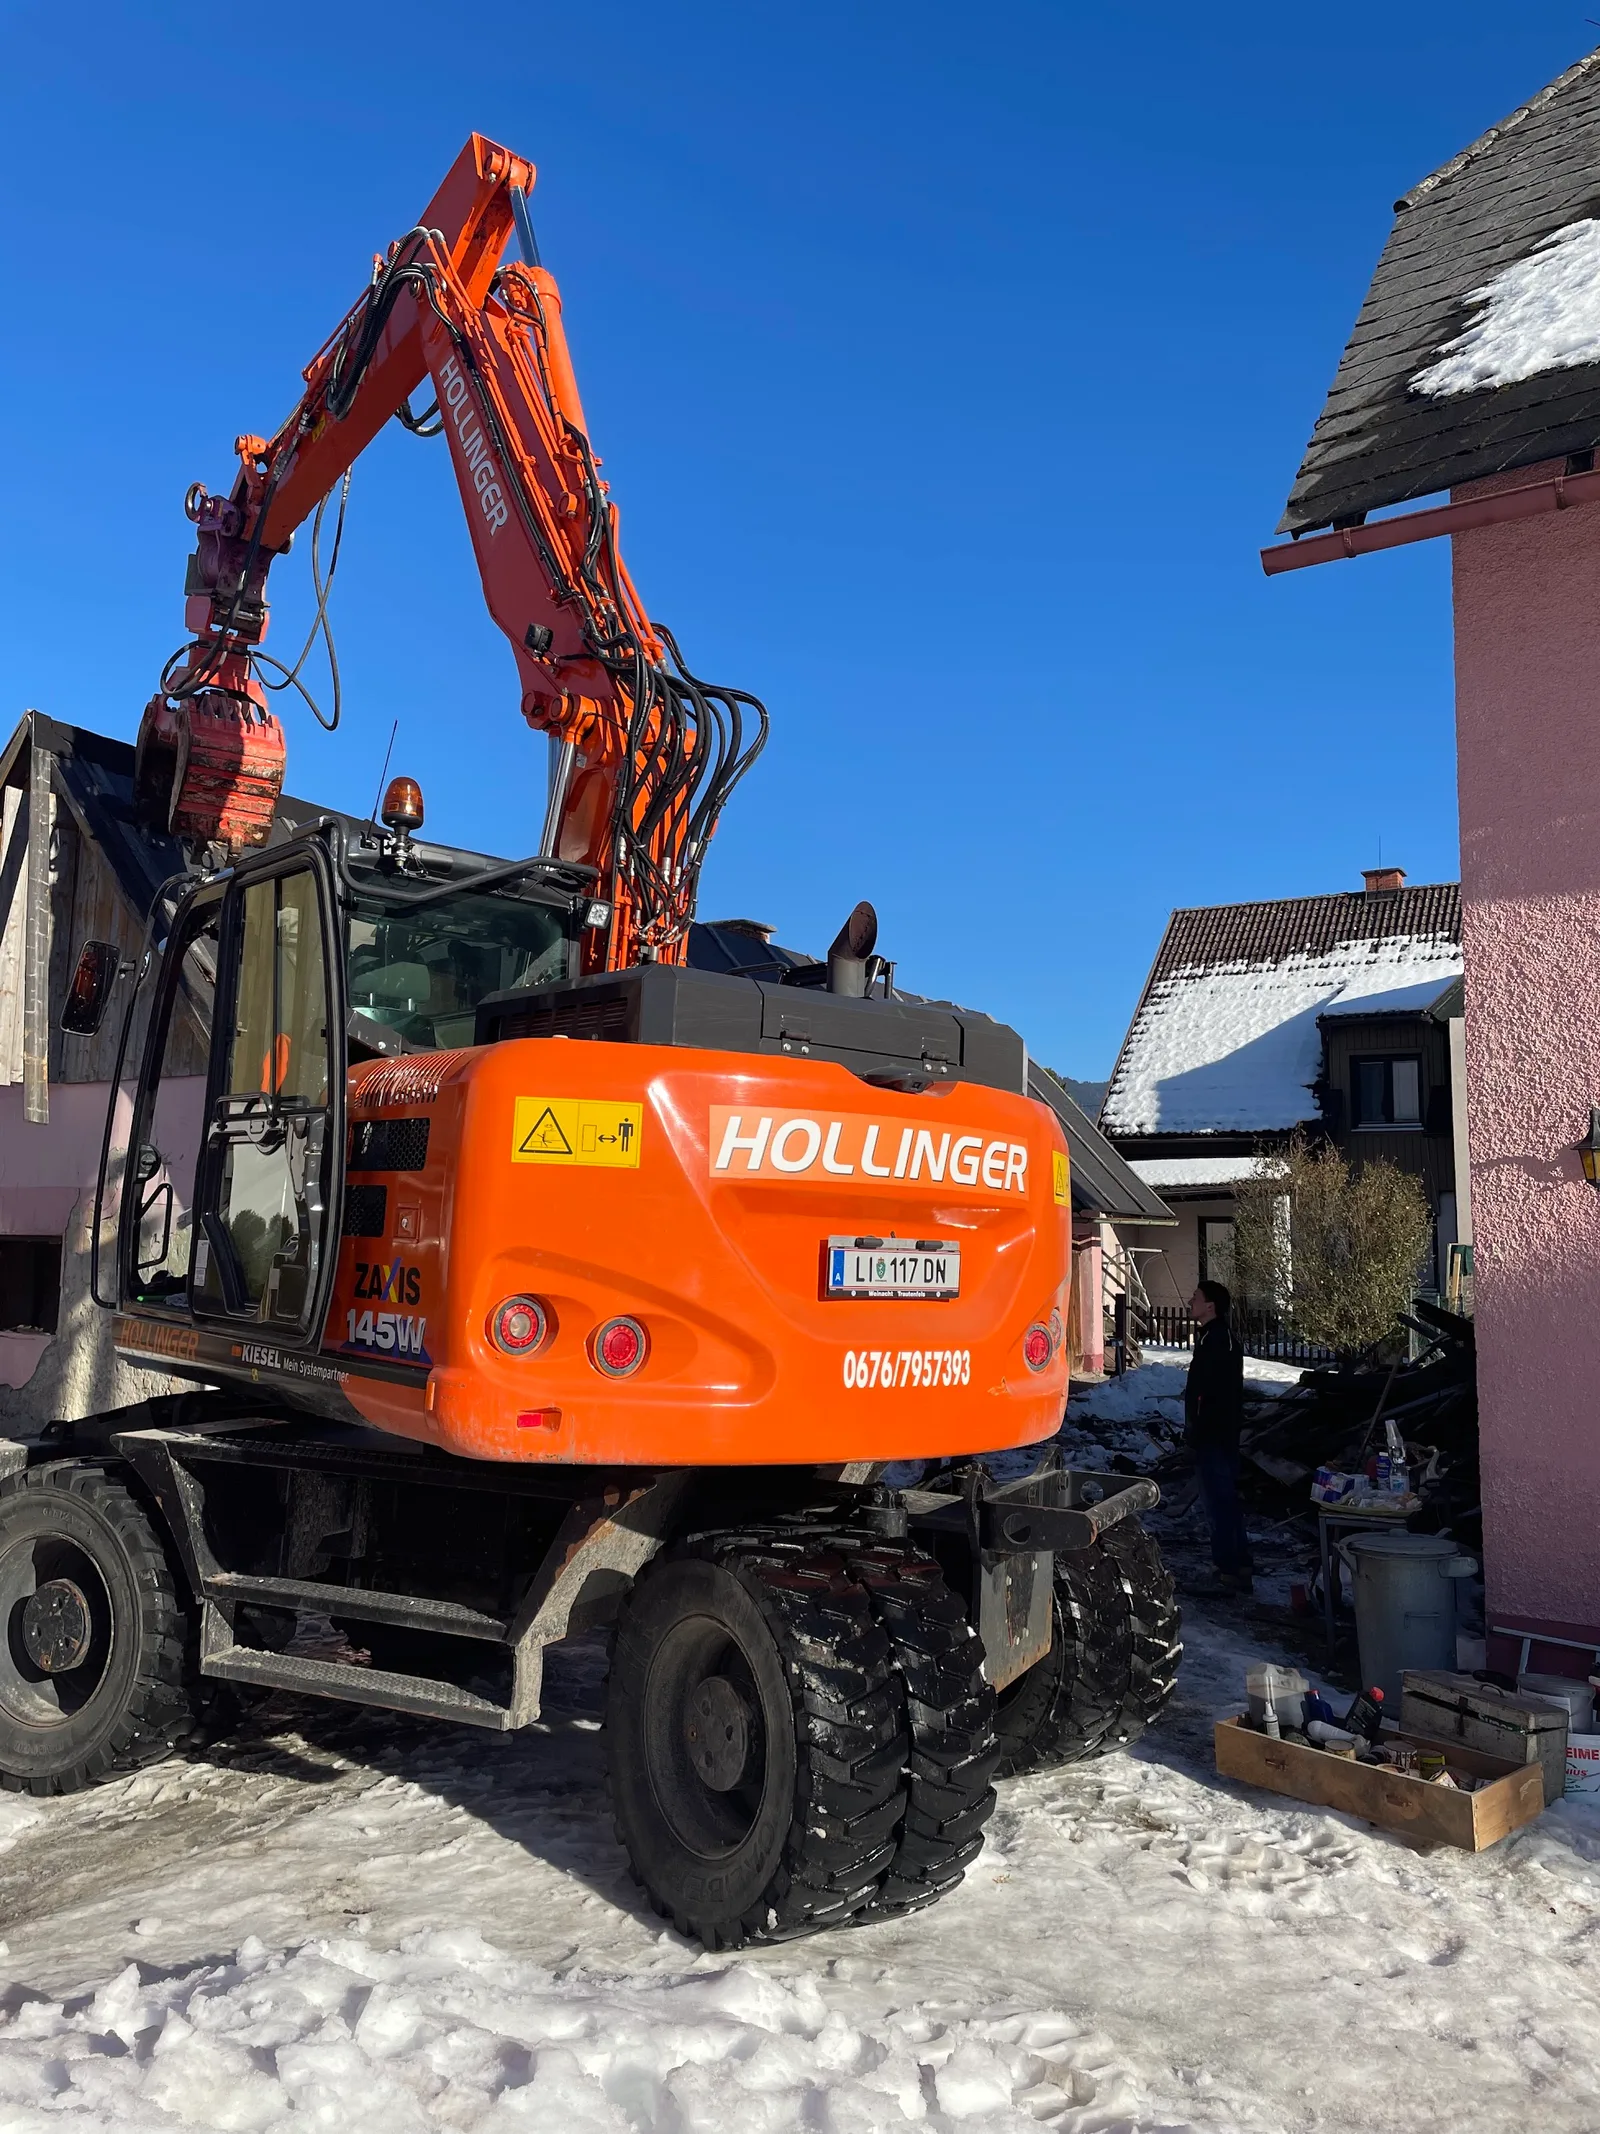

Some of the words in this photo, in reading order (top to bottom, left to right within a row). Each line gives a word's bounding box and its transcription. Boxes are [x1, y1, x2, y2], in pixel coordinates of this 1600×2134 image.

[439, 355, 509, 537] HOLLINGER
[714, 1115, 1028, 1193] HOLLINGER
[354, 1256, 421, 1306] ZAXIS
[835, 1273, 841, 1281] A
[855, 1256, 873, 1282] LI
[890, 1257, 918, 1283] 117
[924, 1258, 946, 1283] DN
[120, 1320, 199, 1360] HOLLINGER
[346, 1308, 427, 1355] 145W
[241, 1344, 281, 1369] KIESEL
[283, 1357, 299, 1373] Mein
[843, 1350, 970, 1389] 0676/7957393
